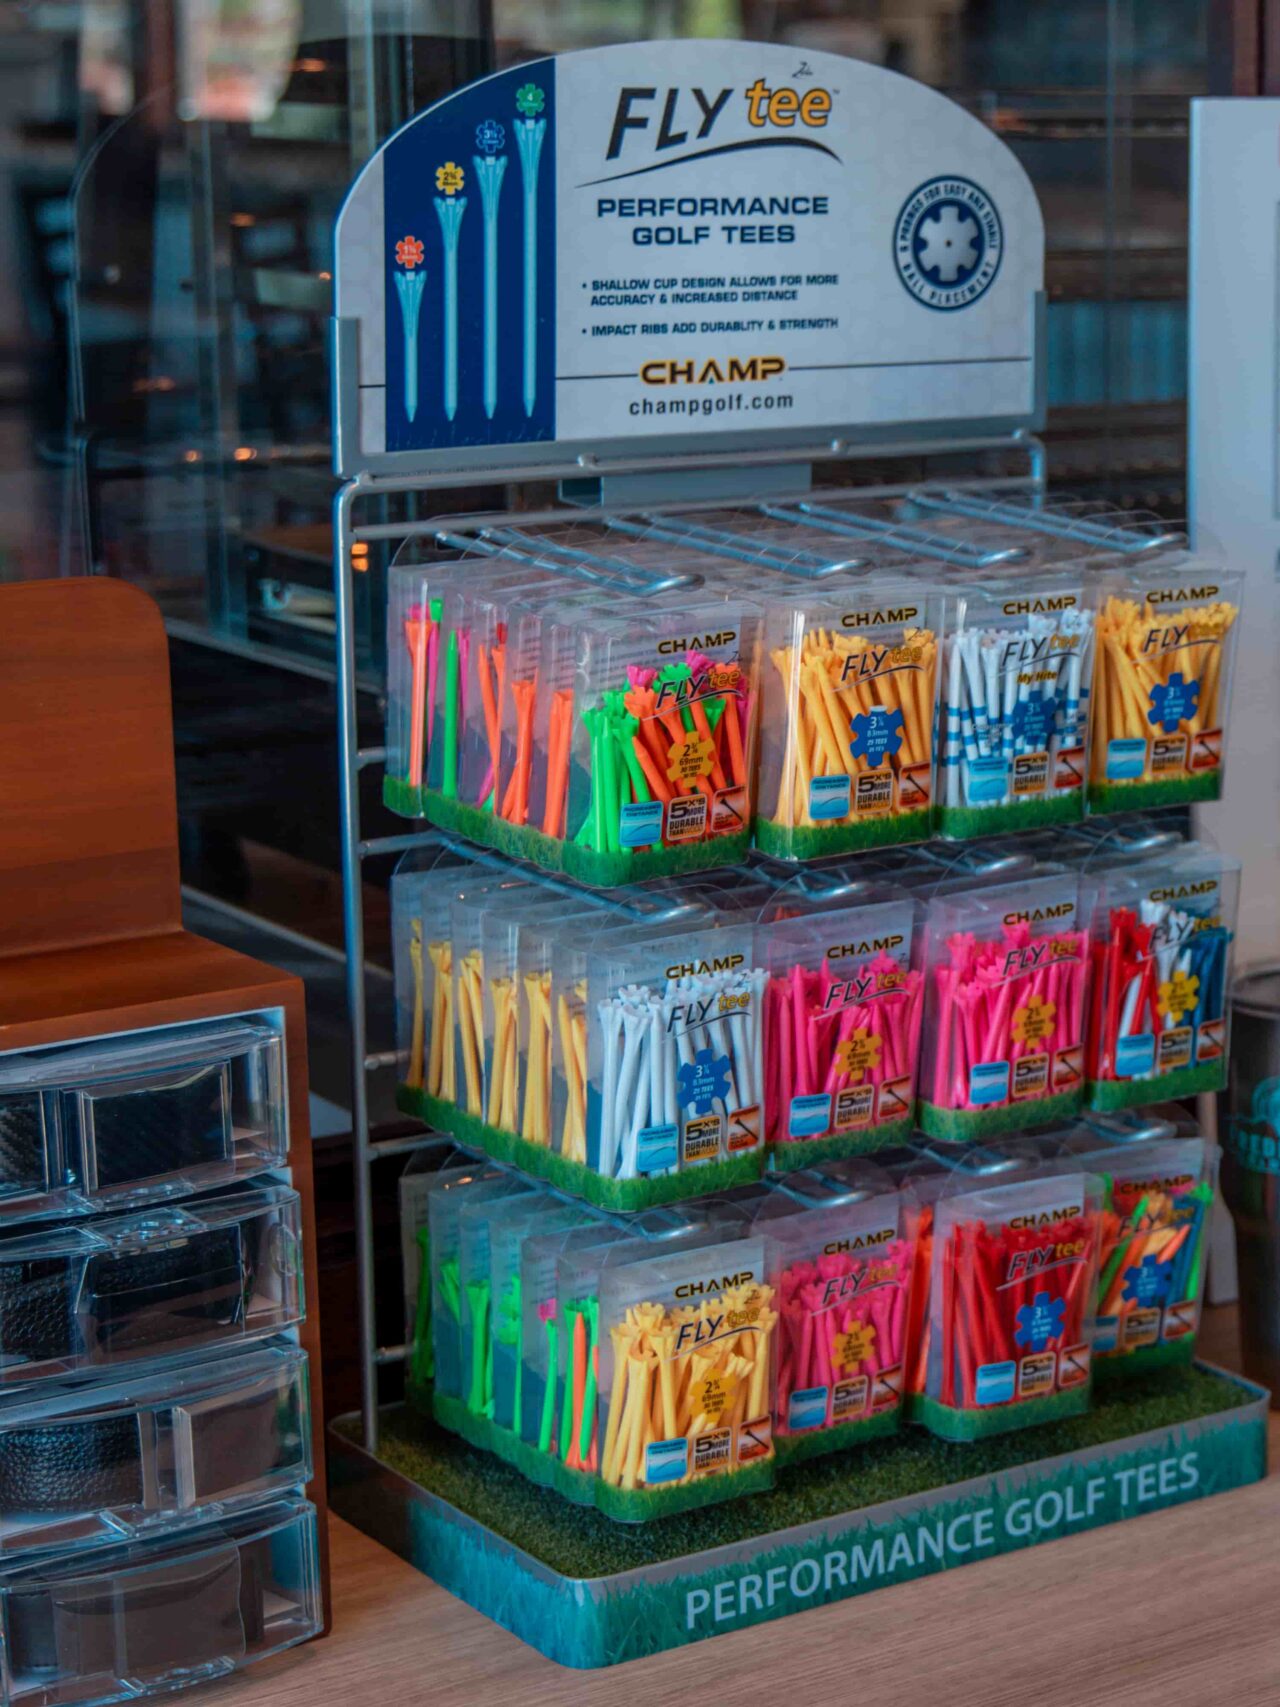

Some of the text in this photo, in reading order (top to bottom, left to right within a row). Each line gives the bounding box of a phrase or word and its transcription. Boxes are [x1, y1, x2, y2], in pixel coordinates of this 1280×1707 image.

[605, 77, 833, 161] FLY tee
[597, 196, 829, 217] PERFORMANCE
[632, 224, 795, 245] GOLF TEES
[591, 274, 839, 291] SHALLOW CUP DESIGN ALLOWS FOR MORE
[590, 290, 799, 306] ACCURACY & INCREASED DISTANCE
[591, 325, 638, 337] IMPACT
[640, 323, 669, 335] RIBS
[671, 322, 697, 333] ADD
[767, 319, 776, 331] &
[778, 318, 839, 330] STRENGTH
[640, 356, 786, 385] CHAMP
[628, 393, 794, 416] champgolf.com
[1003, 595, 1077, 616] CHAMP
[1146, 585, 1219, 604] CHAMP
[841, 607, 918, 628] CHAMP
[657, 631, 737, 654] CHAMP
[1143, 624, 1190, 653] FLY
[1002, 636, 1047, 668] FLY
[841, 648, 889, 682] FLY
[655, 668, 740, 709] FLY tee
[669, 815, 705, 830] DURABLE
[1149, 880, 1218, 903] CHAMP
[1003, 902, 1074, 926] CHAMP
[827, 935, 904, 959] CHAMP
[1003, 942, 1047, 977] FLY
[665, 953, 745, 979] CHAMP
[825, 976, 873, 1010] FLY
[666, 991, 751, 1033] FLY tee
[685, 1136, 719, 1152] DURABLE
[1009, 1206, 1082, 1230] CHAMP
[824, 1229, 896, 1256] CHAMP
[1006, 1243, 1056, 1281] FLY
[675, 1271, 754, 1298] CHAMP
[822, 1267, 869, 1305] FLY
[676, 1314, 724, 1350] FLY
[684, 1451, 1200, 1630] PERFORMANCE GOLF TEES
